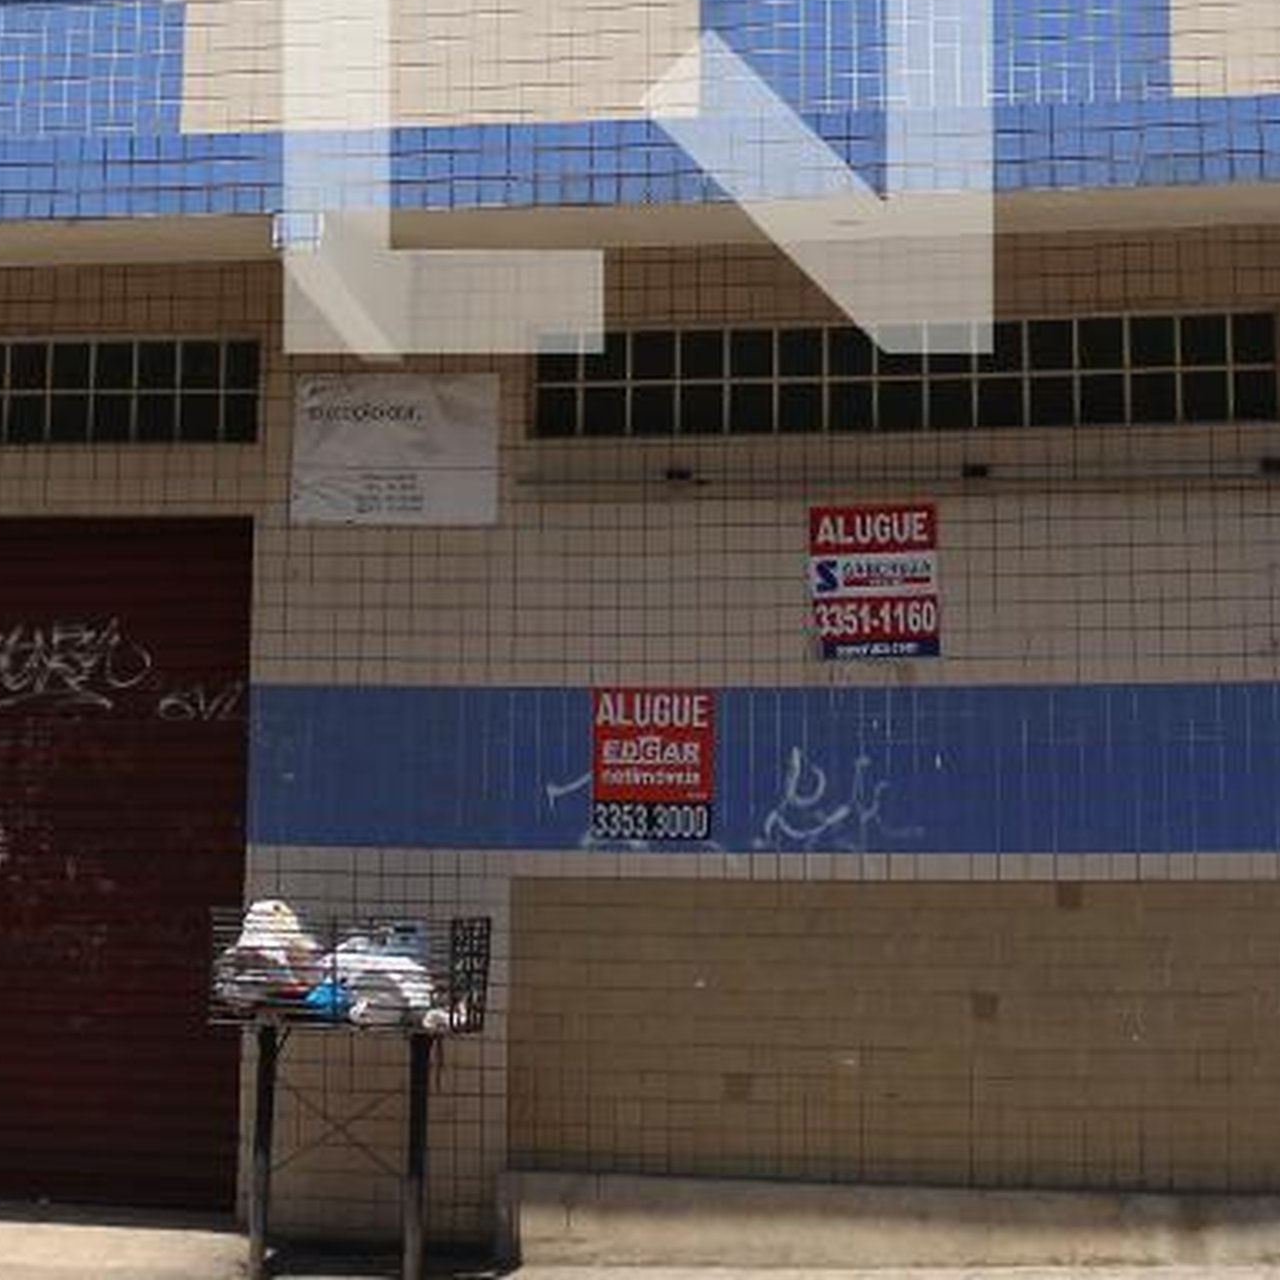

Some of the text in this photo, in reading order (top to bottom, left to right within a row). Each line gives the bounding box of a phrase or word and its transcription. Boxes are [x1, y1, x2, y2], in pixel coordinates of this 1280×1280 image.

[817, 511, 928, 545] ALUGUE
[816, 600, 936, 637] 3351-1160
[596, 692, 709, 728] ALUGUE
[602, 735, 701, 766] EDGAR
[595, 803, 709, 839] 3353.3000
